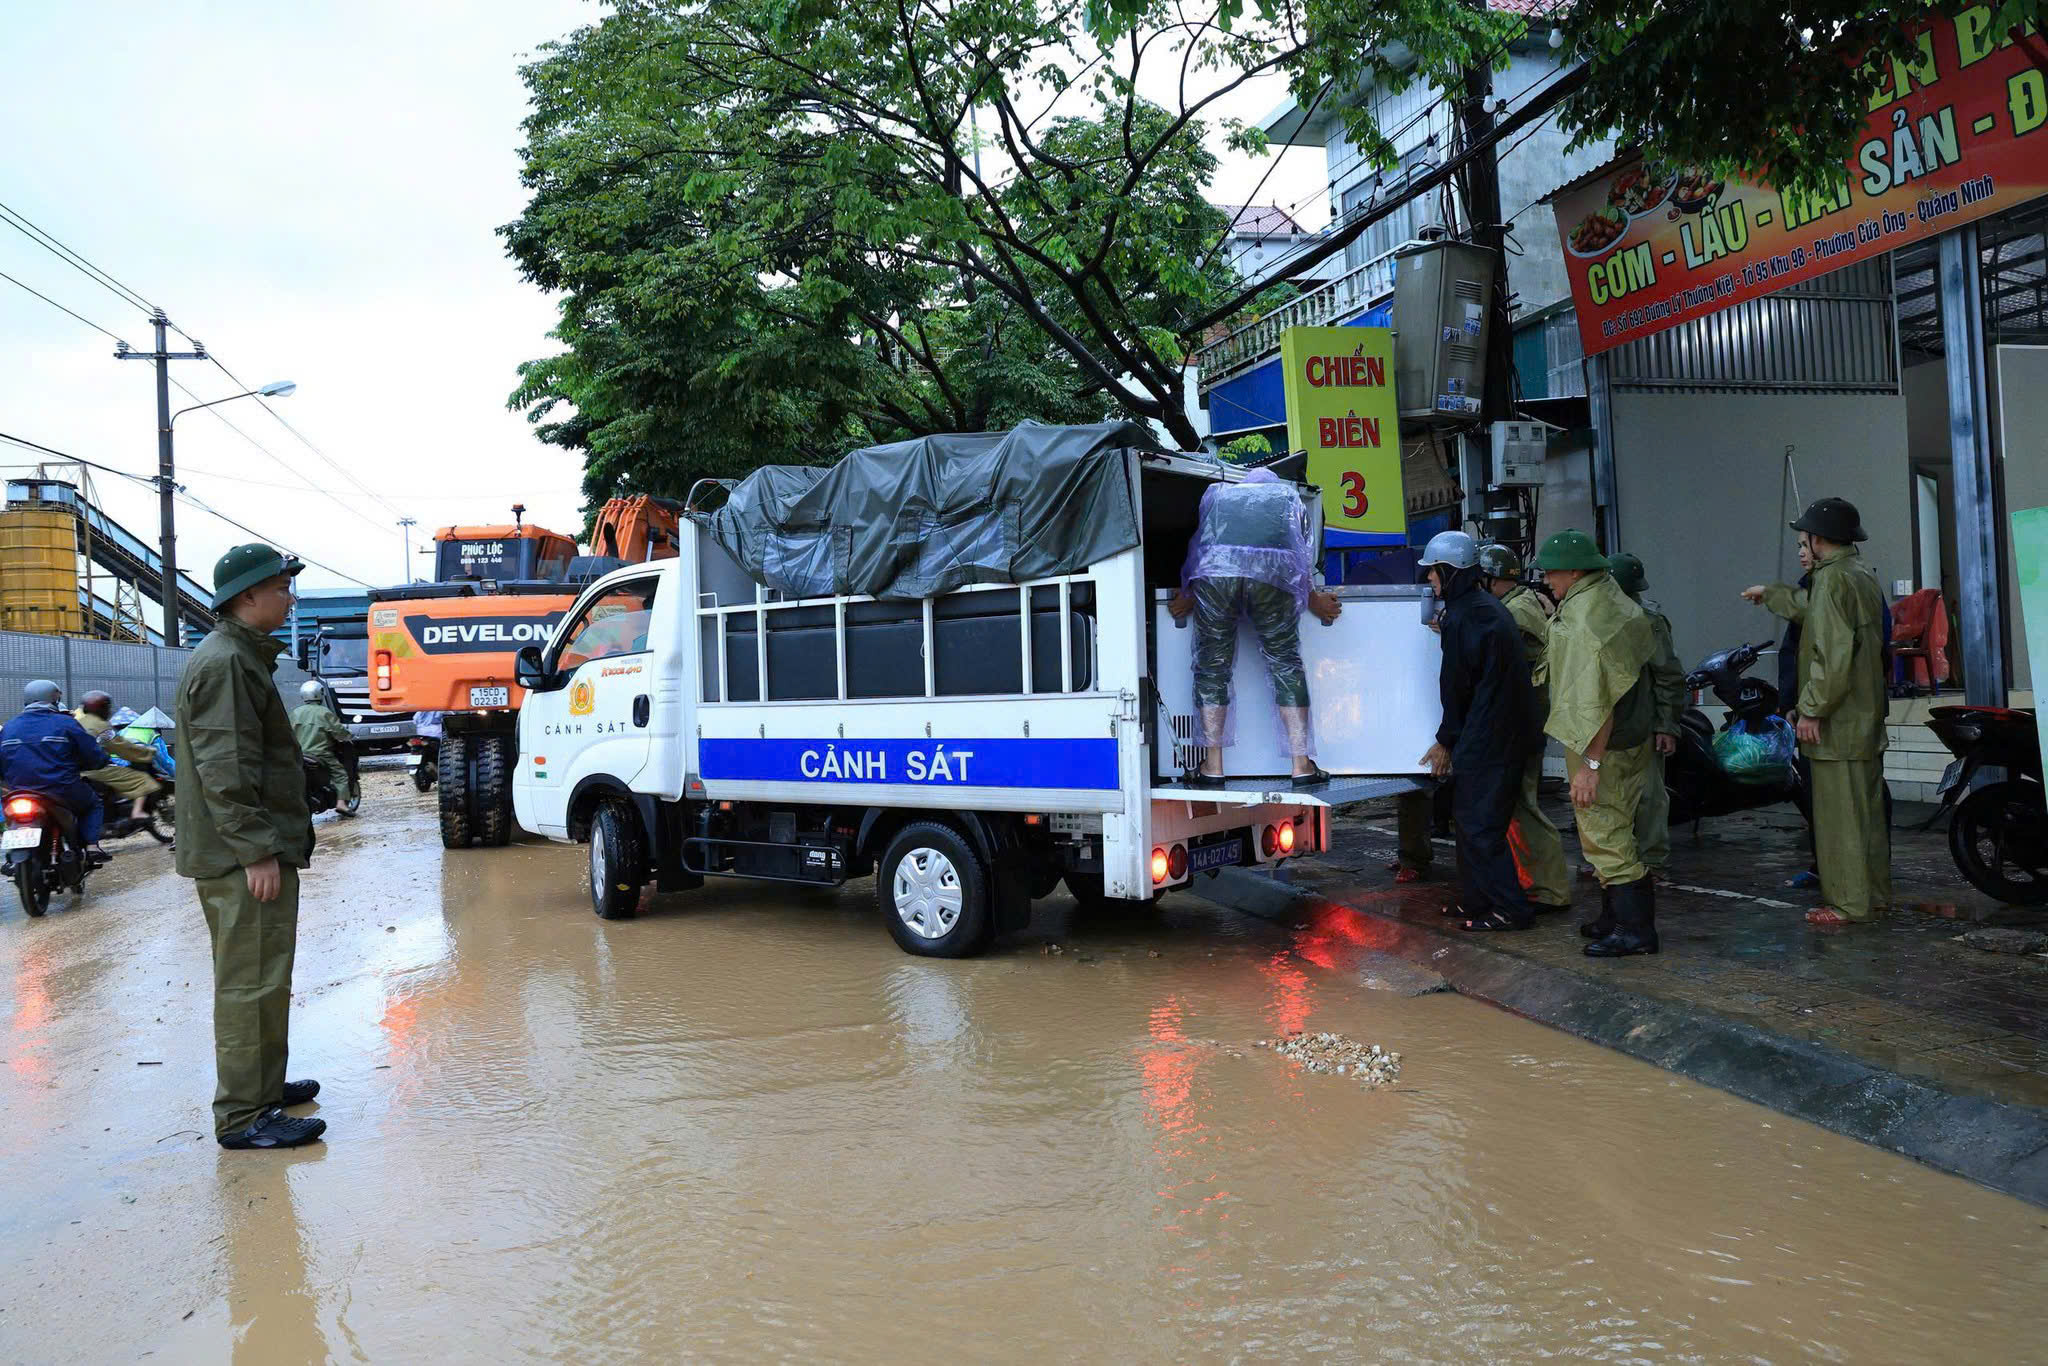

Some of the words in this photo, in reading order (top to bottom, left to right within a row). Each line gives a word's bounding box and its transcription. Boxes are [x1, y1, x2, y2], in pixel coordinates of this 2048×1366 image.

[1587, 240, 1657, 305] CƠM
[1680, 193, 1748, 270] LẨU
[1860, 106, 1960, 197] SẢN
[1769, 251, 1791, 275] Khu
[1814, 229, 1857, 260] Phường
[1857, 217, 1881, 244] Cửa
[1882, 209, 1906, 235] Ông
[1917, 191, 1958, 222] Quảng
[1960, 174, 1994, 205] Ninh
[1305, 342, 1385, 388] CHIẾN
[1318, 410, 1381, 448] BIÊN
[1340, 471, 1368, 519] 3
[461, 542, 484, 556] PHÚC
[487, 541, 503, 557] LỘC
[423, 624, 553, 644] DEVELON
[479, 688, 500, 697] 15CD
[800, 744, 886, 779] CẢNH
[906, 744, 974, 781] SÁT
